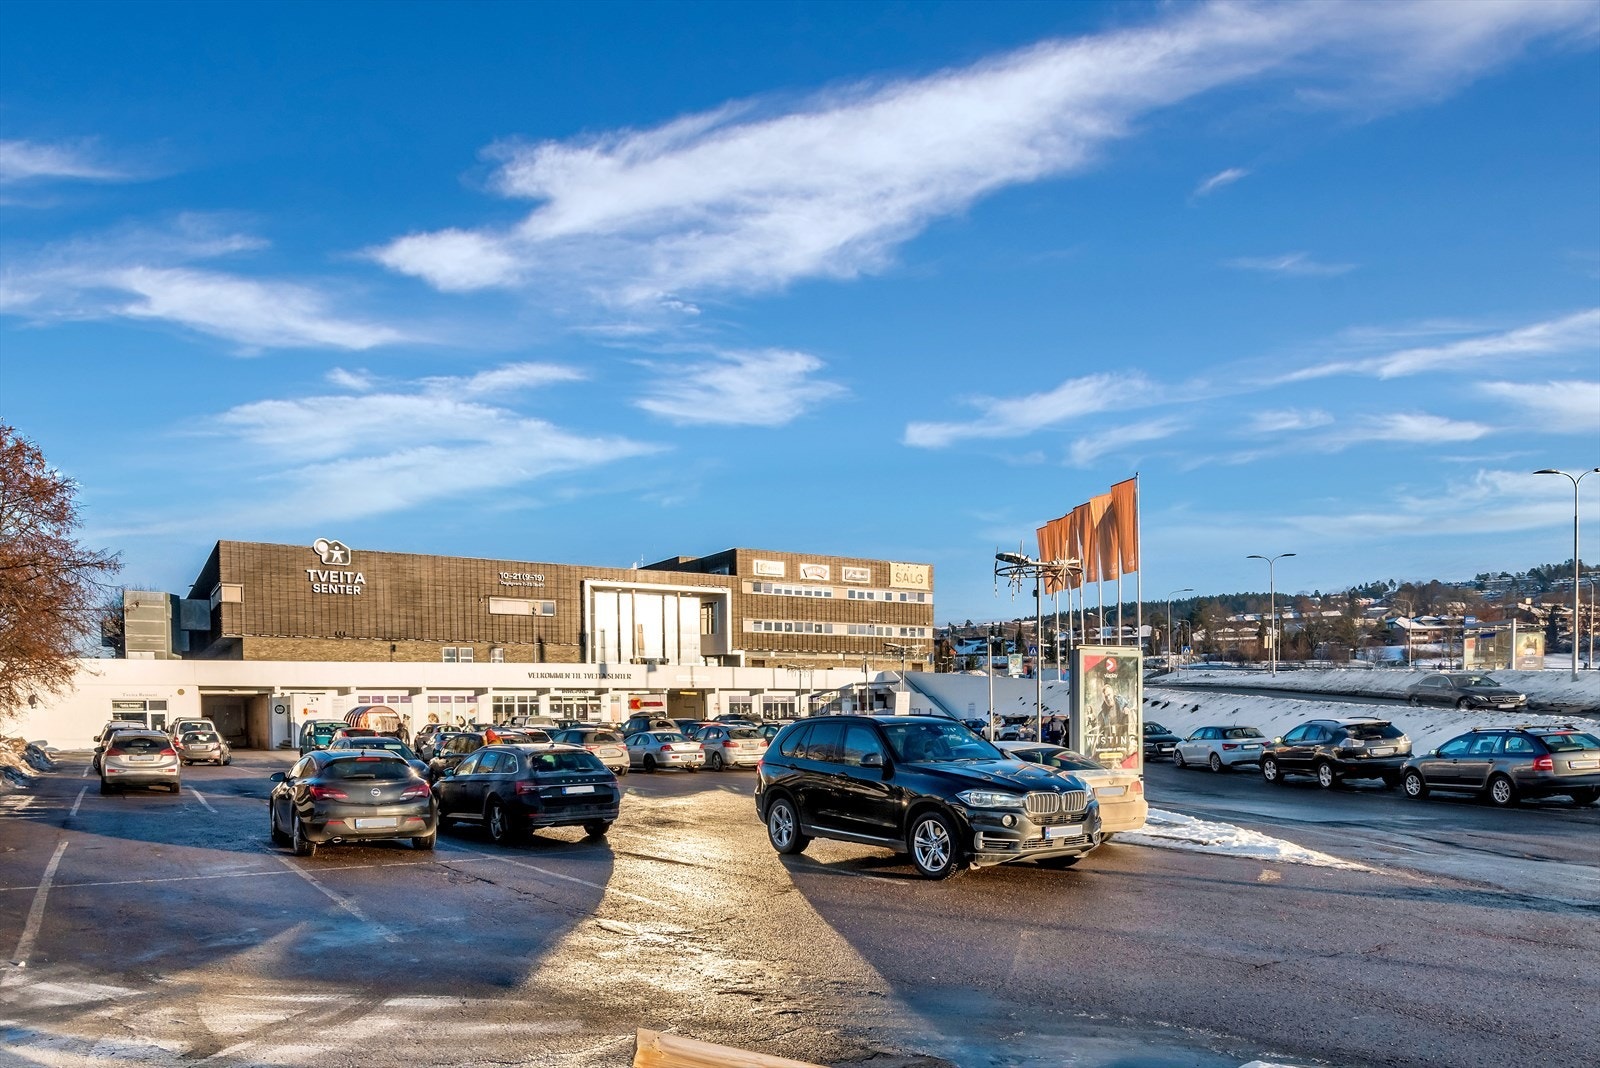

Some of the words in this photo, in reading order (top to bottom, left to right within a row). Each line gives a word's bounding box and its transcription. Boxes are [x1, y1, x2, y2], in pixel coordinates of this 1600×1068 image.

[306, 569, 366, 584] TVEITA
[895, 571, 924, 584] SALG
[313, 583, 361, 595] SENTER
[1086, 735, 1136, 746] WISTING
